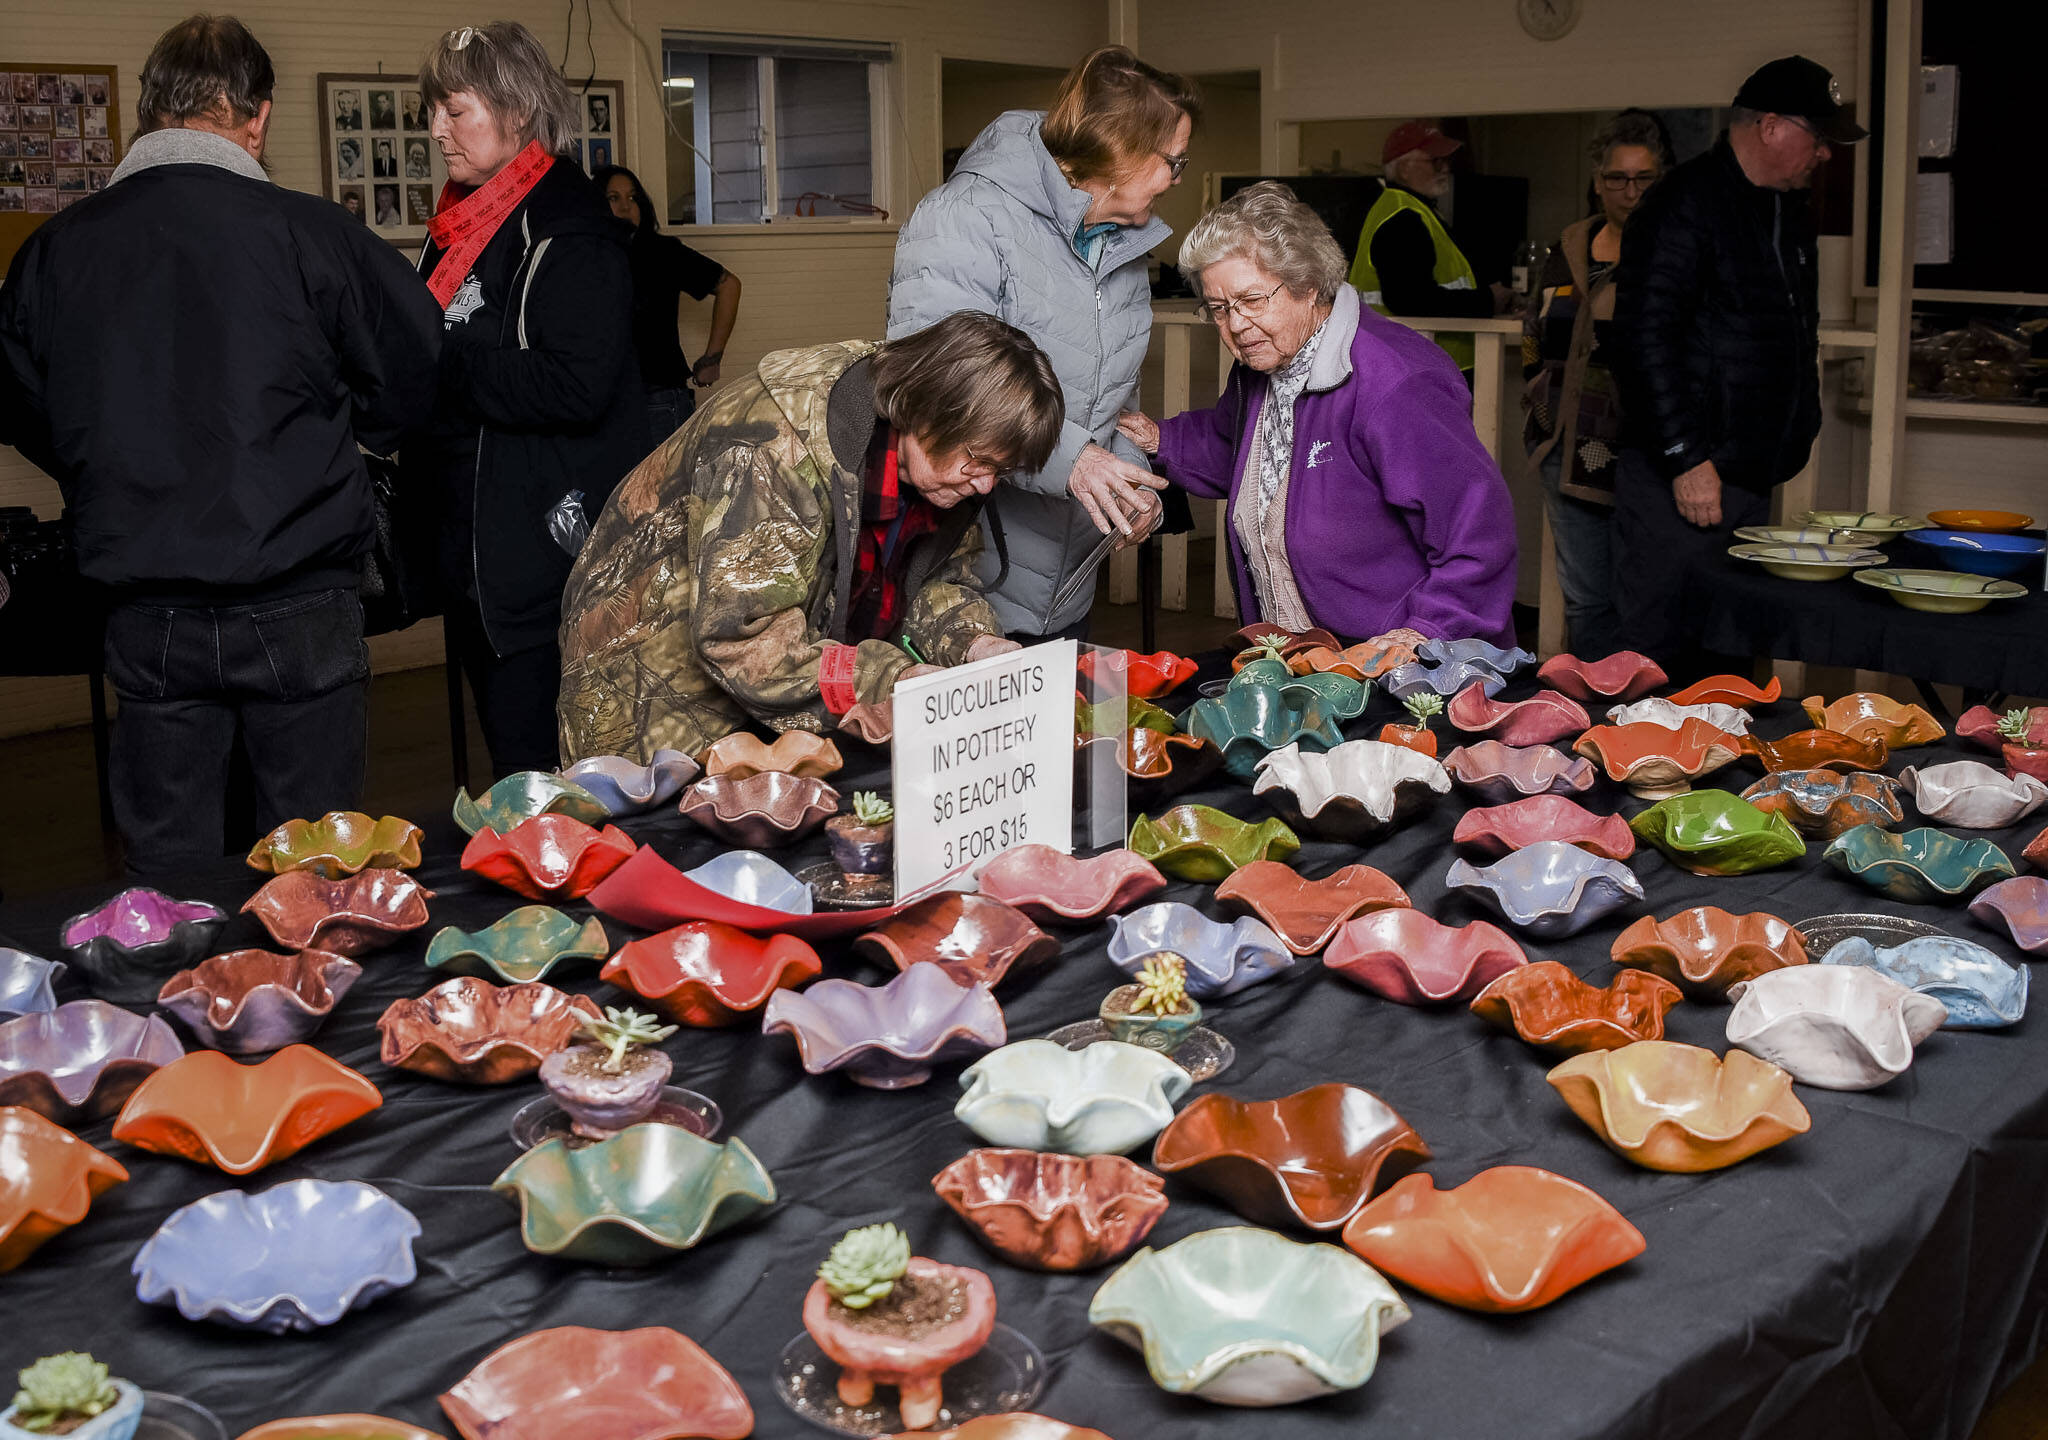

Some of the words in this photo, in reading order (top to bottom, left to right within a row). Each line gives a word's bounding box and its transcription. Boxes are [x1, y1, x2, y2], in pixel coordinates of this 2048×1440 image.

[925, 665, 1044, 724] SUCCULENTS
[933, 744, 950, 773] IN
[956, 714, 1037, 766] POTTERY
[933, 792, 954, 824] $6
[960, 772, 1006, 814] EACH
[1012, 763, 1036, 794] OR
[943, 841, 952, 870] 3
[959, 826, 995, 864] FOR
[1000, 812, 1028, 850] $15
